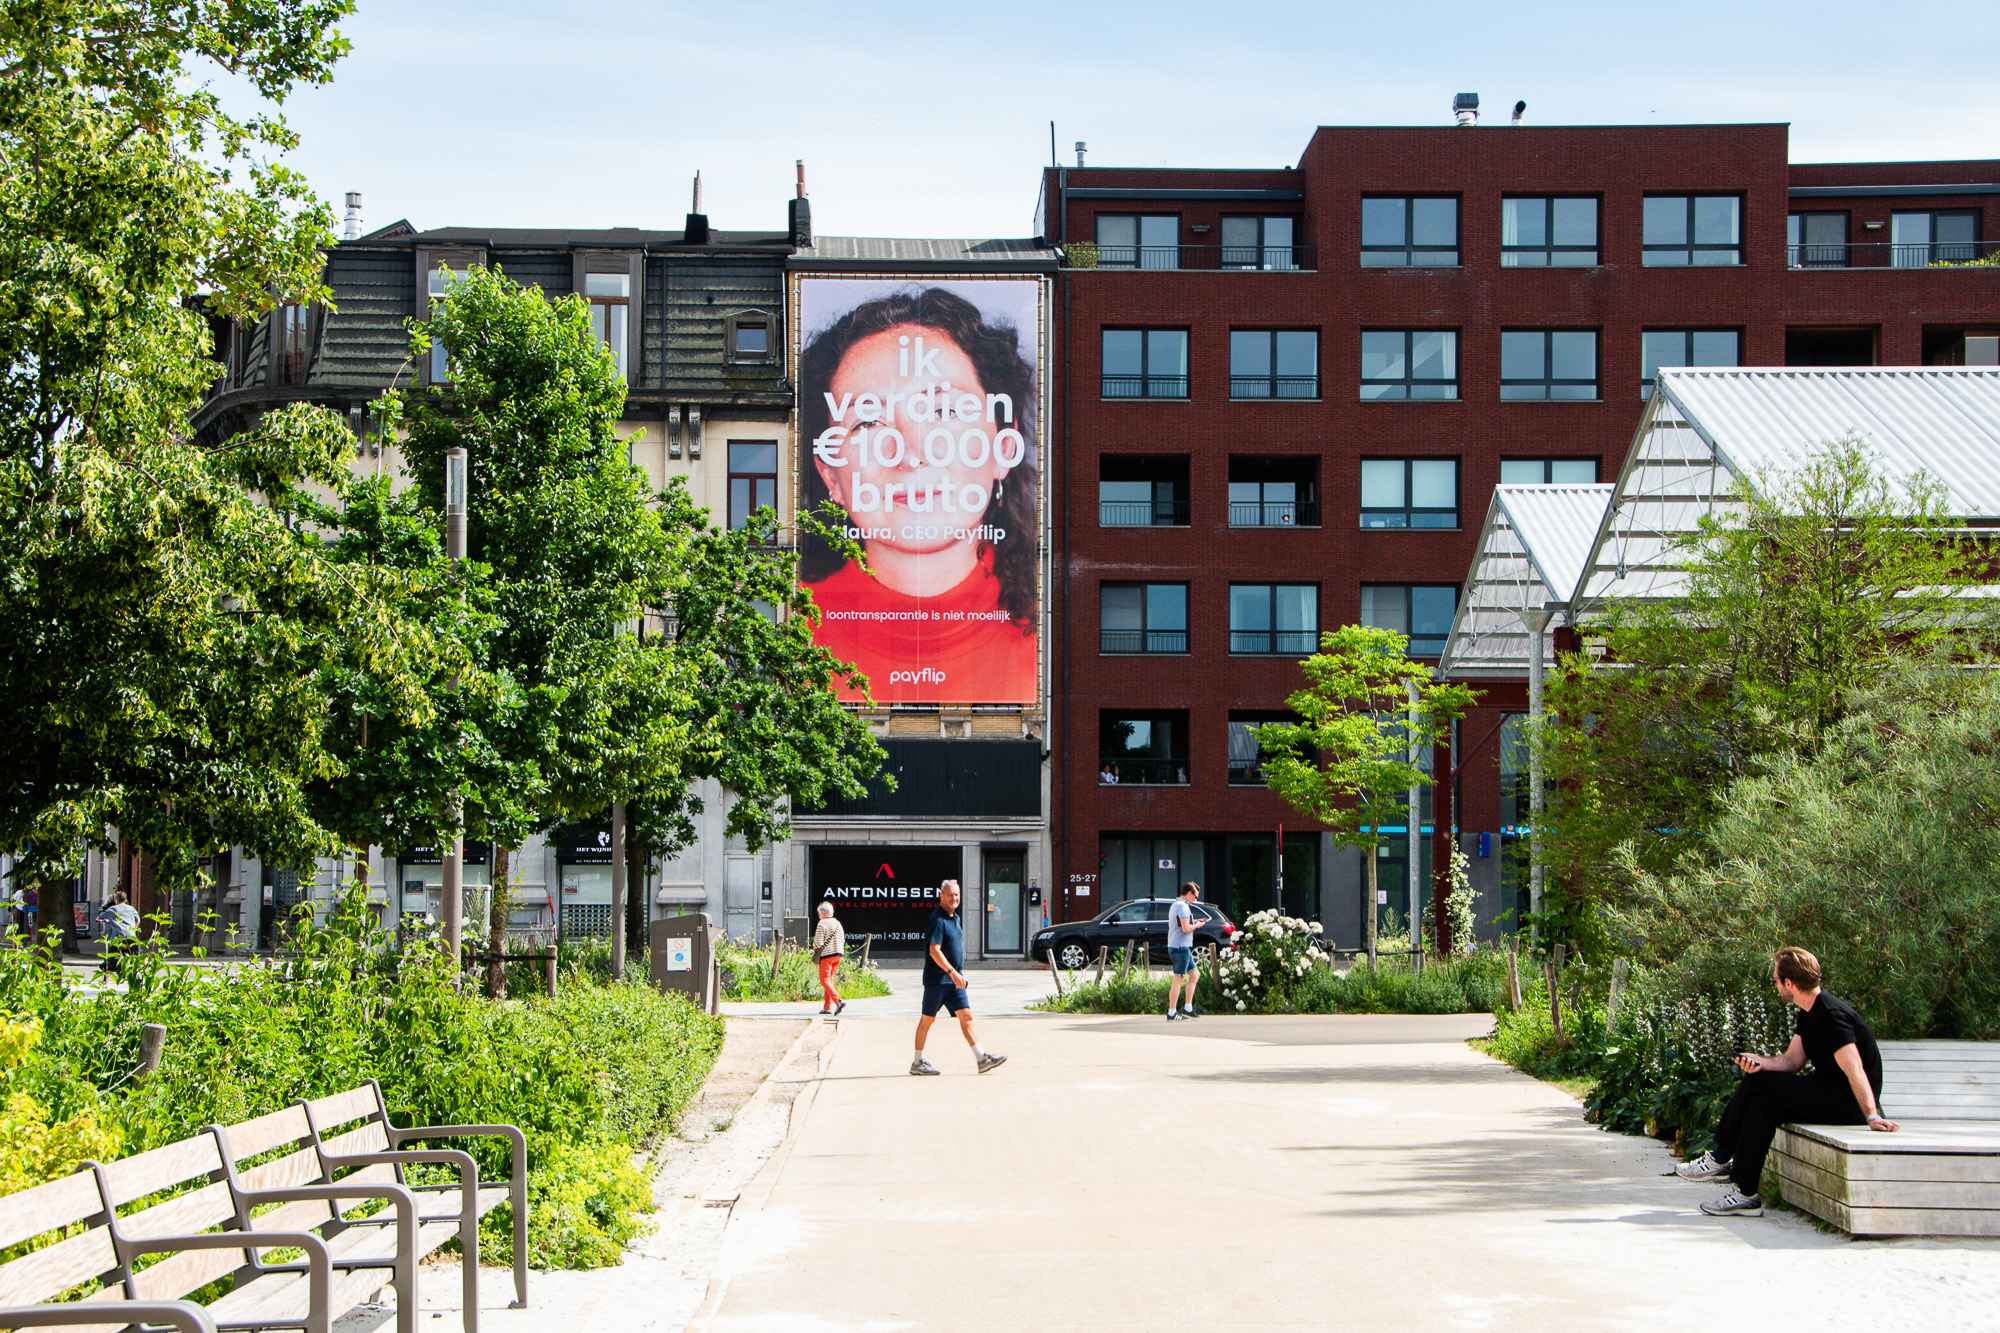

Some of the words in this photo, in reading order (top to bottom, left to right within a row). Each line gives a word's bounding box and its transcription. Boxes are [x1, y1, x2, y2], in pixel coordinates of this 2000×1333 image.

[898, 335, 942, 377] ik
[823, 381, 1014, 423] verdien
[812, 426, 1026, 469] €10.000
[851, 472, 988, 513] bruto
[901, 525, 939, 540] CEO
[943, 524, 1006, 545] Payflip
[826, 610, 929, 622] loontransparantie
[931, 610, 941, 621] is
[943, 610, 965, 621] niet
[967, 610, 1011, 623] moeilijk
[889, 668, 946, 684] payflip
[1070, 874, 1097, 883] 25-27
[901, 932, 906, 940] 3
[907, 932, 920, 940] 808
